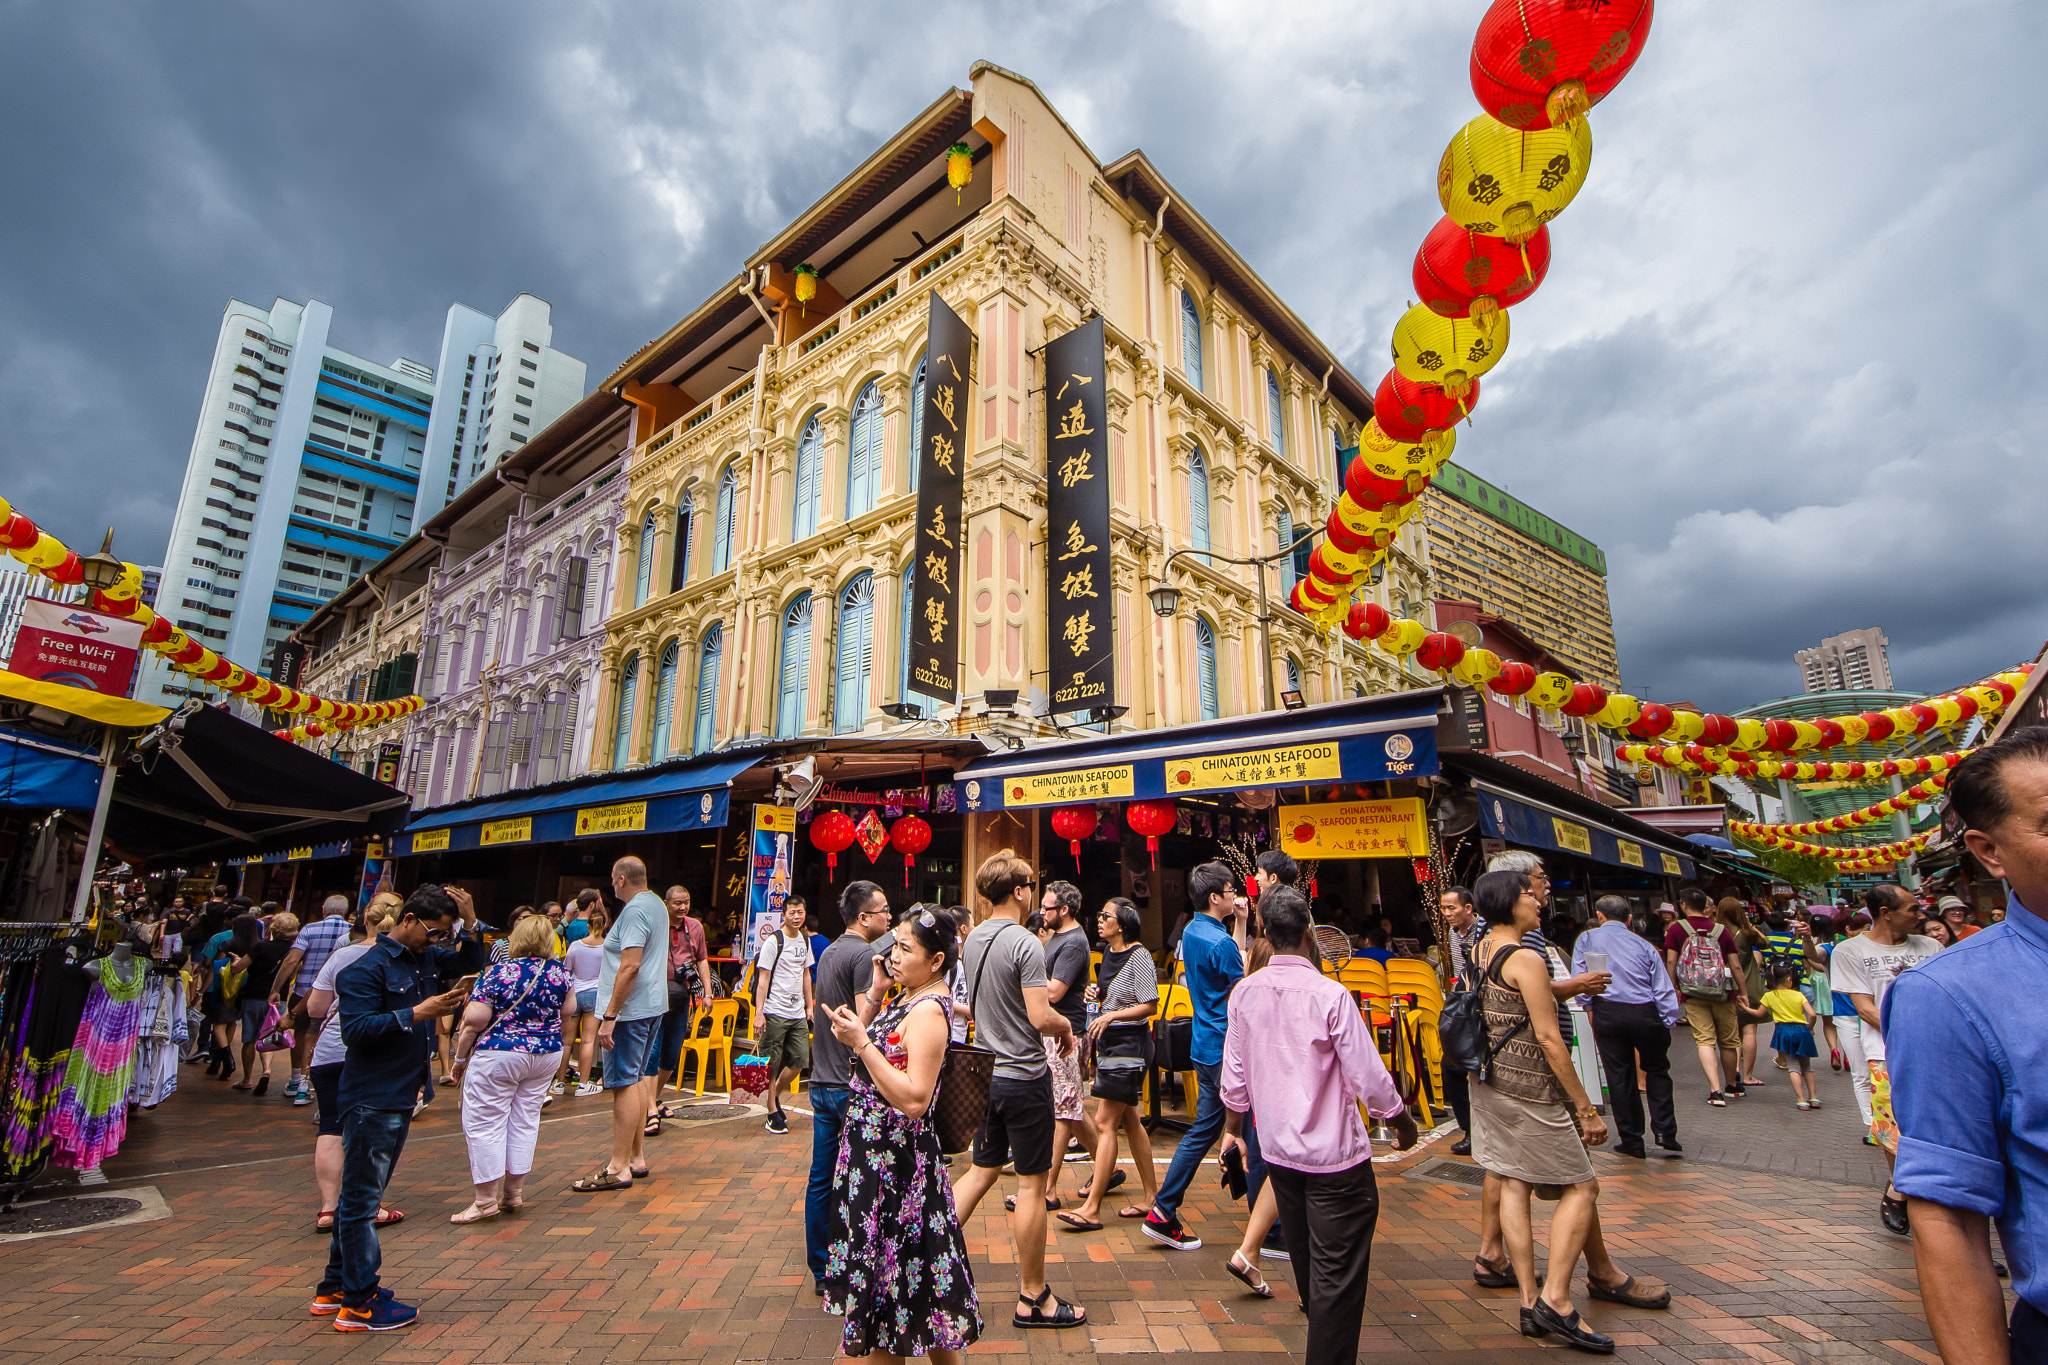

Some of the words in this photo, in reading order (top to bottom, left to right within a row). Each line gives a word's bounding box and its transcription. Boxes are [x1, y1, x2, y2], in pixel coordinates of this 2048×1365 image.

[40, 636, 74, 652] Free
[79, 643, 116, 661] Wi-Fi
[37, 652, 108, 674] 免费无线互联网
[280, 652, 294, 683] drama
[915, 667, 934, 686] 6222
[934, 673, 953, 691] 2224
[1055, 685, 1079, 702] 6222
[1080, 681, 1106, 698] 2224
[1201, 753, 1271, 771] CHINATOWN
[1274, 746, 1332, 763] SEAFOOD
[1385, 761, 1415, 775] Tiger
[1032, 773, 1084, 788] CHINATOWN
[1085, 769, 1128, 781] SEAFOOD
[1221, 762, 1307, 782] 八道馆鱼虾蟹
[820, 781, 877, 803] Chinatown
[592, 807, 620, 819] CHINATOWN
[621, 805, 644, 816] SEAFOOD
[966, 800, 981, 810] Tiger
[1339, 805, 1392, 816] CHINATOWN
[1320, 815, 1357, 826] SEAFOOD
[1359, 813, 1415, 825] RESTAURANT
[1355, 828, 1380, 836] 牛车水
[1863, 957, 1879, 966] BB
[1881, 955, 1916, 965] JEANS
